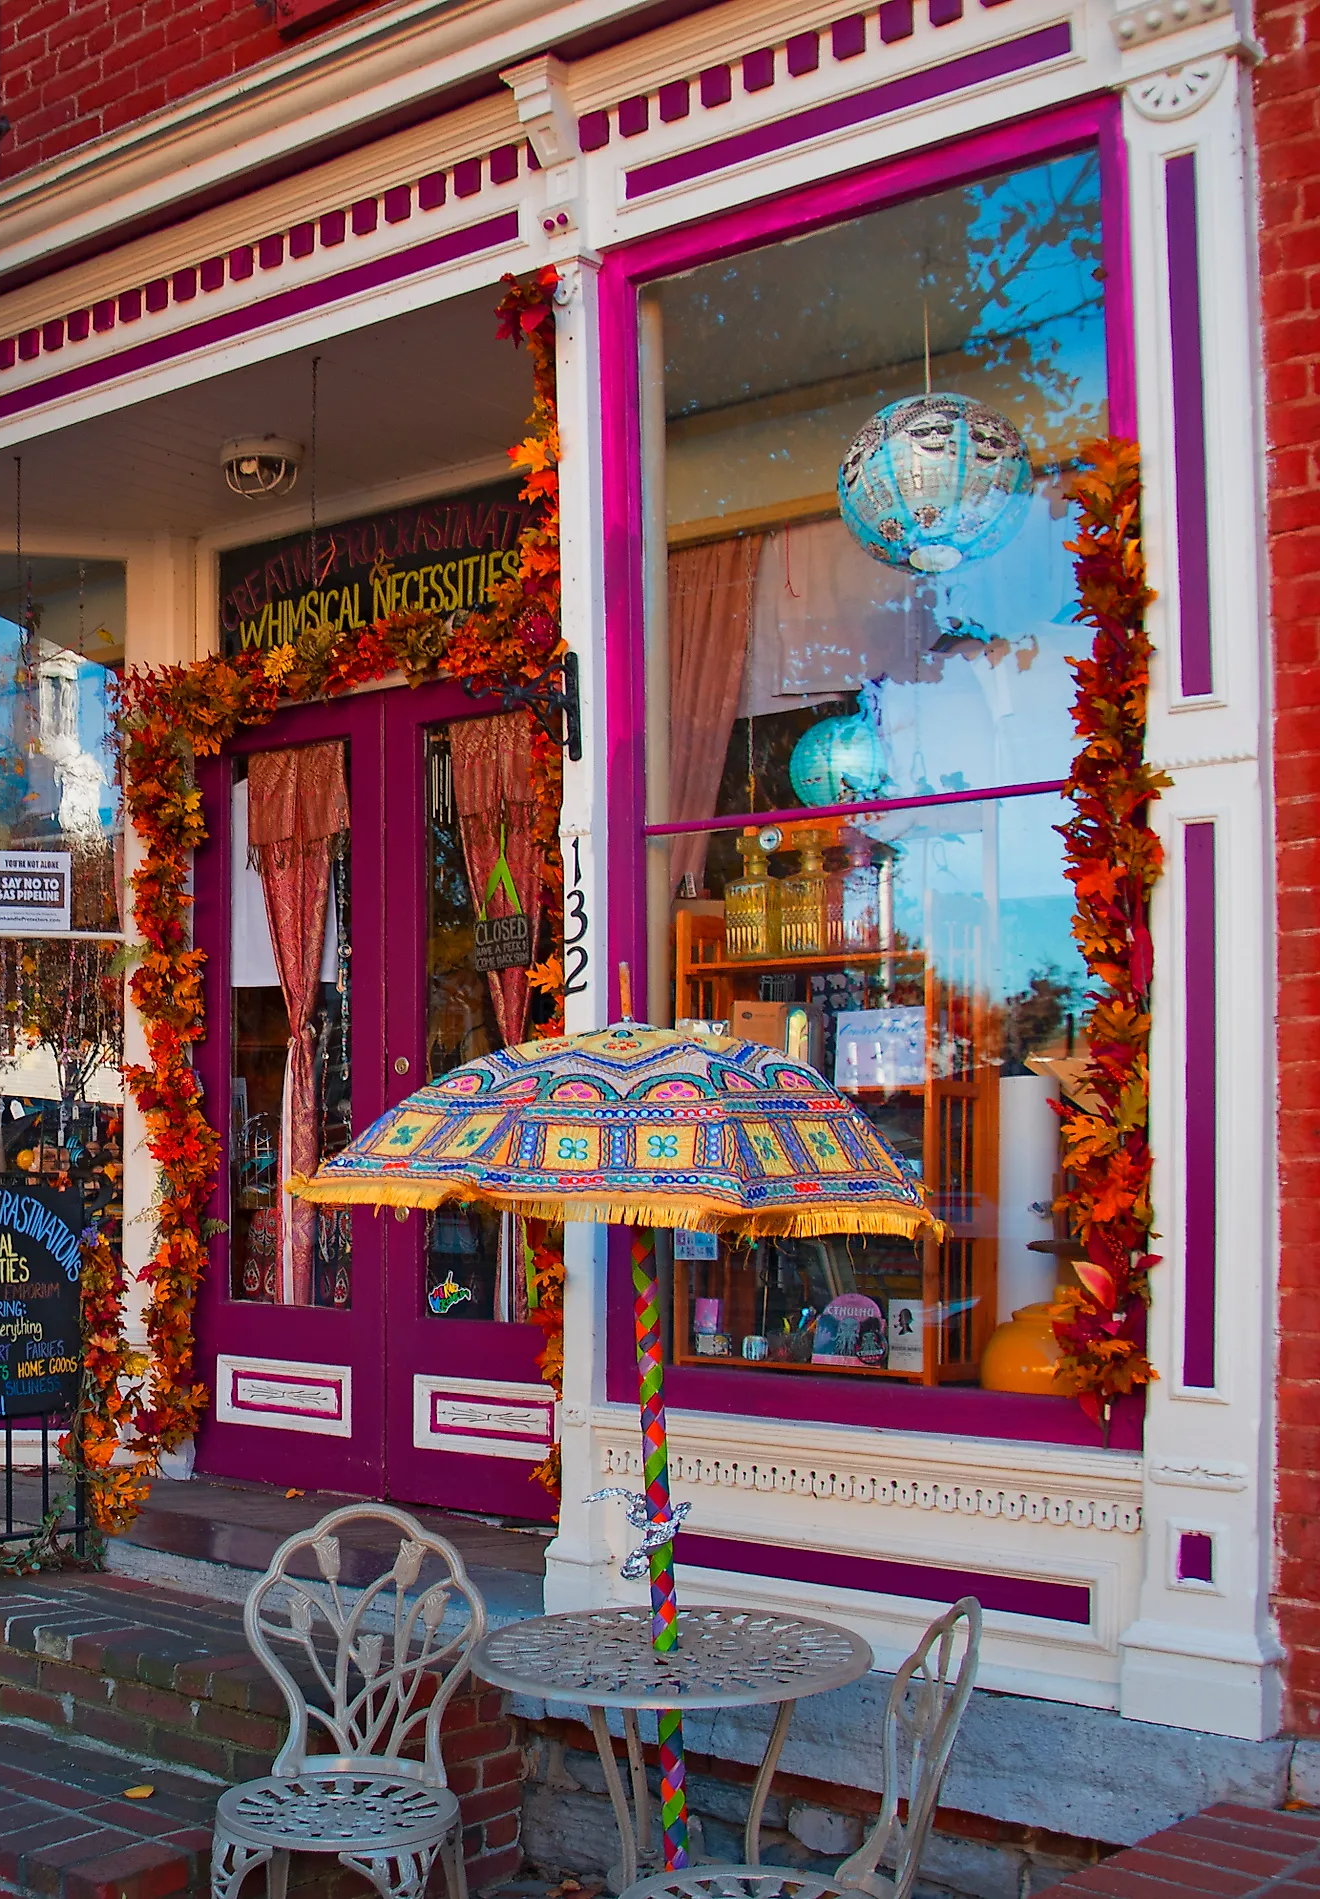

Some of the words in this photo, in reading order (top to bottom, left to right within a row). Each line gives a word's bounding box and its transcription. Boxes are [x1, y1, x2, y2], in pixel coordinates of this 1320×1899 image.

[238, 582, 366, 651] WHIMSICAL
[372, 548, 523, 626] NECESSITIES
[5, 859, 26, 869] YOU'RE
[27, 860, 39, 869] NOT
[40, 860, 59, 869] ALONE
[1, 877, 23, 889] SAY
[23, 878, 41, 890] NO
[42, 878, 60, 890] TO
[16, 889, 60, 902] PIPELINE
[564, 836, 589, 997] 132
[475, 917, 528, 946] CLOSED
[3, 1282, 61, 1301] EMPORIUM
[827, 1305, 876, 1318] CTHULHU
[25, 1340, 65, 1360] FAIRIES
[17, 1359, 46, 1379] HOME
[48, 1356, 78, 1375] GOODS
[4, 1375, 62, 1397] SILLINESS
